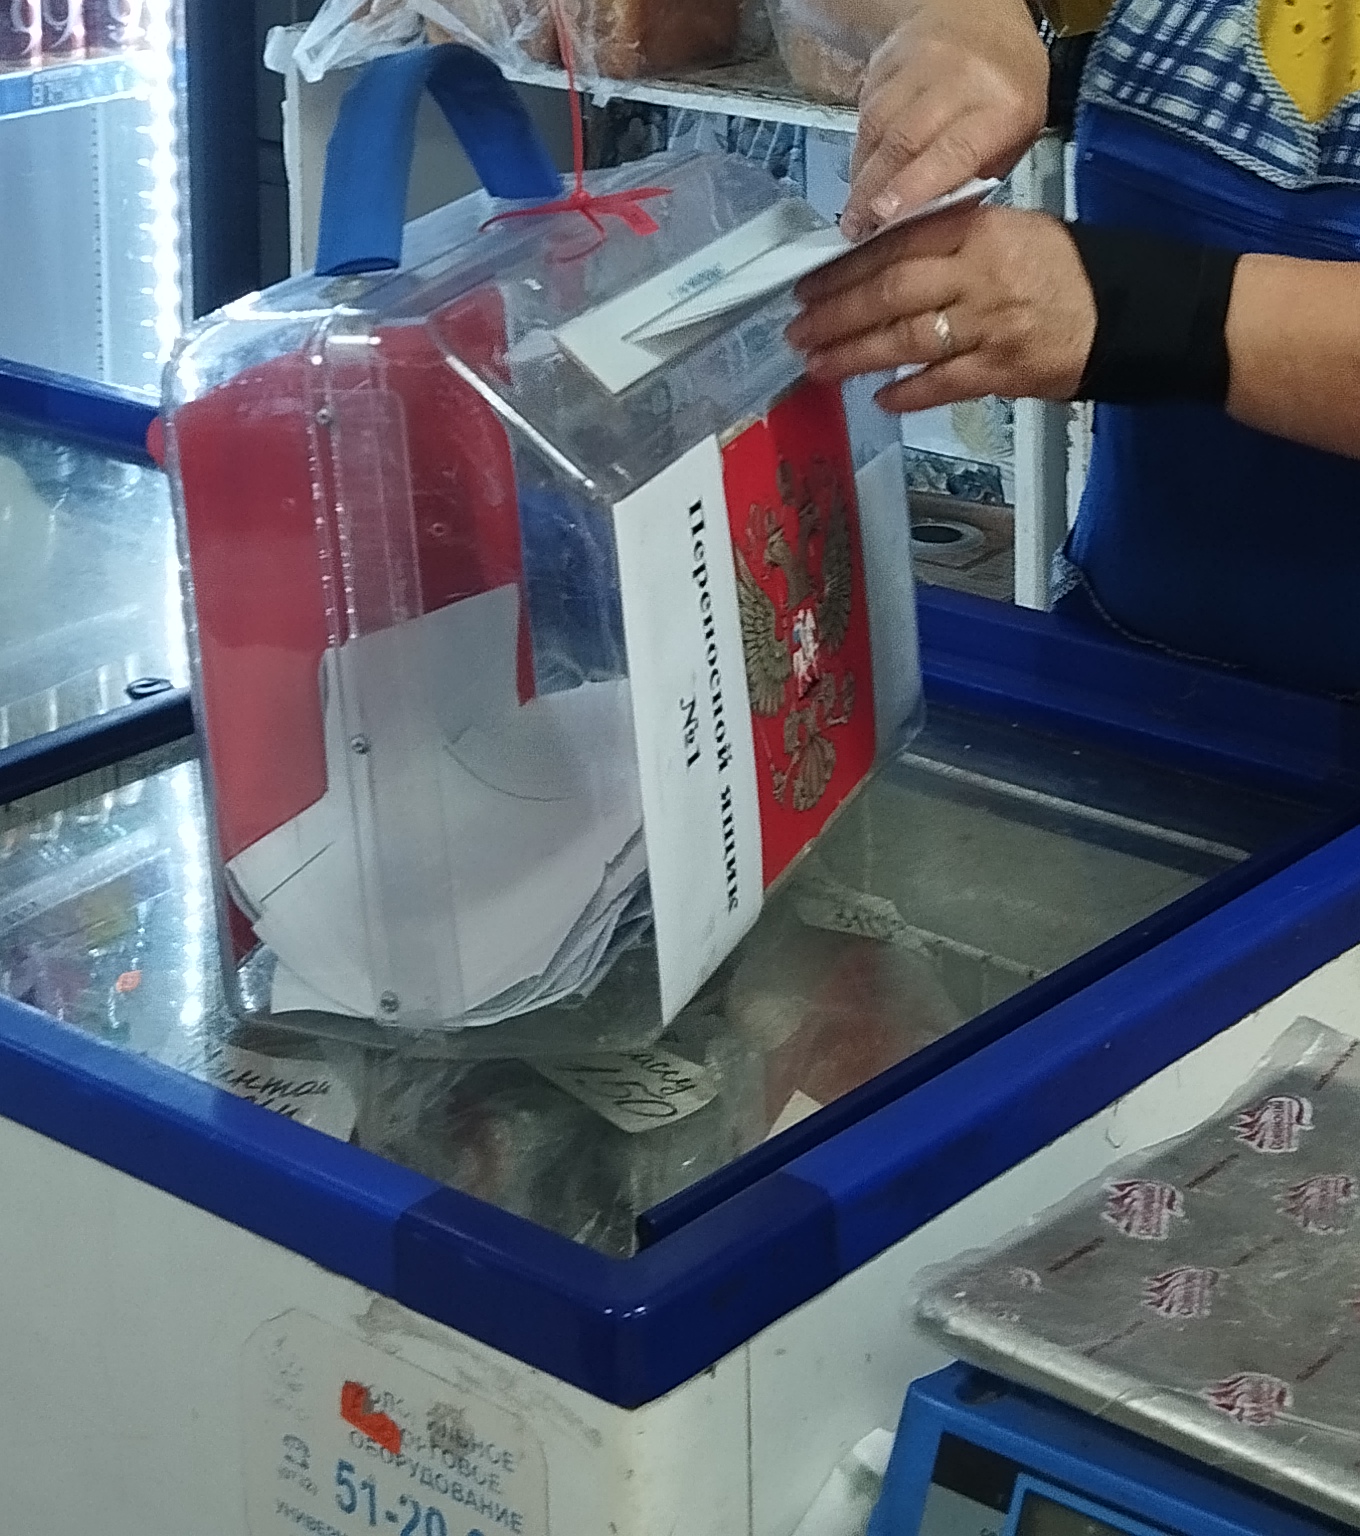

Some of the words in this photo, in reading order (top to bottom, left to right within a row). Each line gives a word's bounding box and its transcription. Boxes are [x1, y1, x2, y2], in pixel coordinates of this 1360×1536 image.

[678, 696, 701, 769] №1
[687, 497, 735, 774] Переносной
[719, 785, 742, 915] ящик
